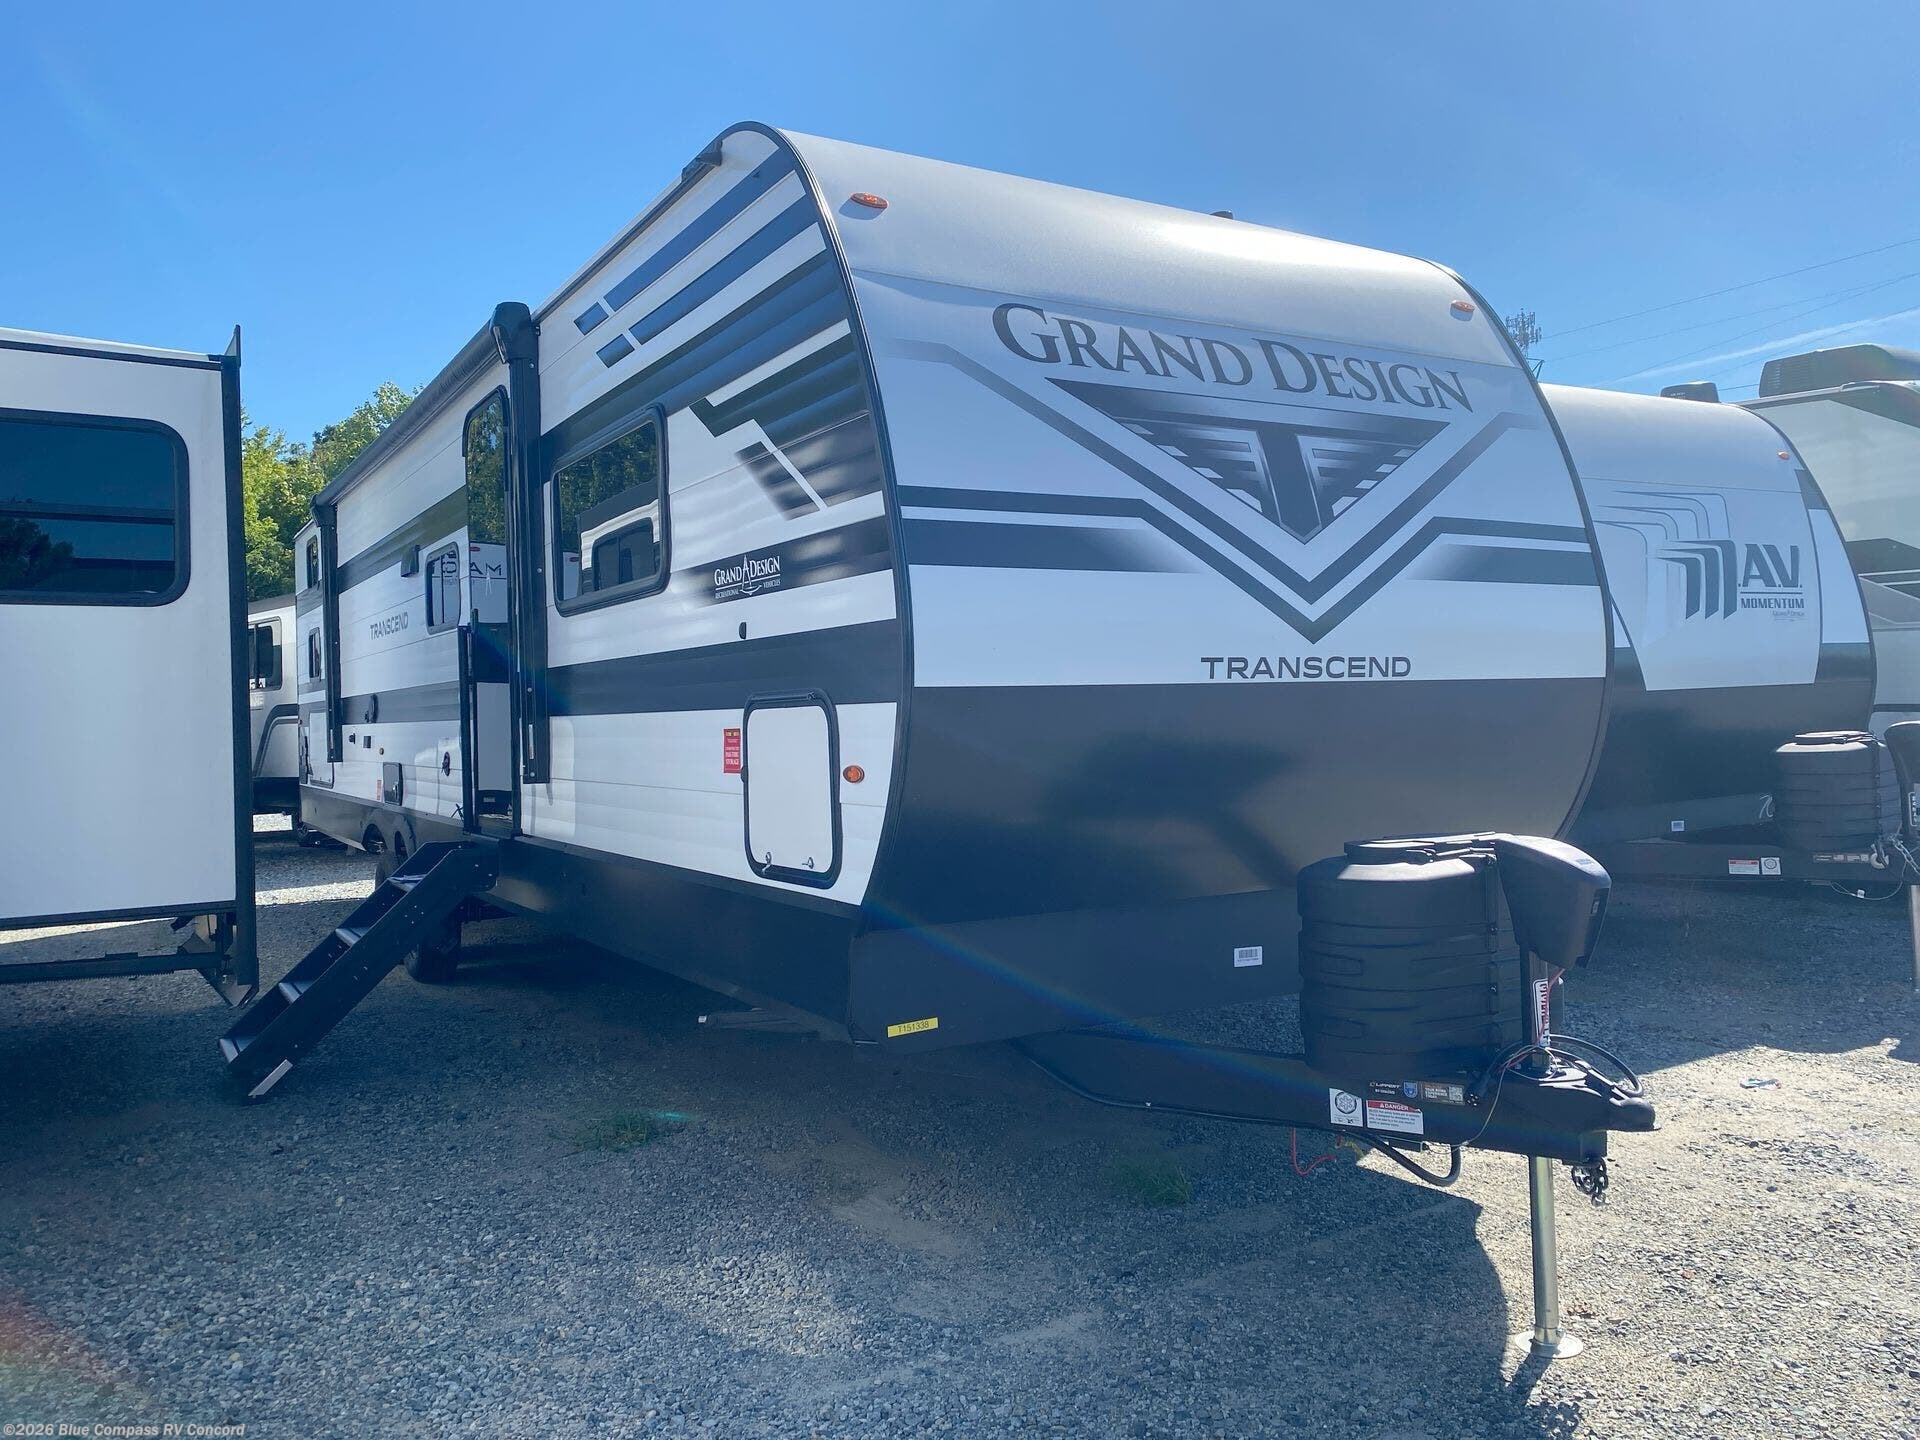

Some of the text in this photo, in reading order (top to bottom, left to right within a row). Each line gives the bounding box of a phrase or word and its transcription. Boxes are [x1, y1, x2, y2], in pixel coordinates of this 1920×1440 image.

[992, 302, 1474, 413] GRAND DESIGN
[714, 556, 780, 586] GRAND DESIGN
[1741, 597, 1805, 609] MOMENTUM
[370, 611, 409, 640] TRANSCEND
[1200, 656, 1412, 680] TRANSCEND
[1384, 1103, 1409, 1111] DANGER
